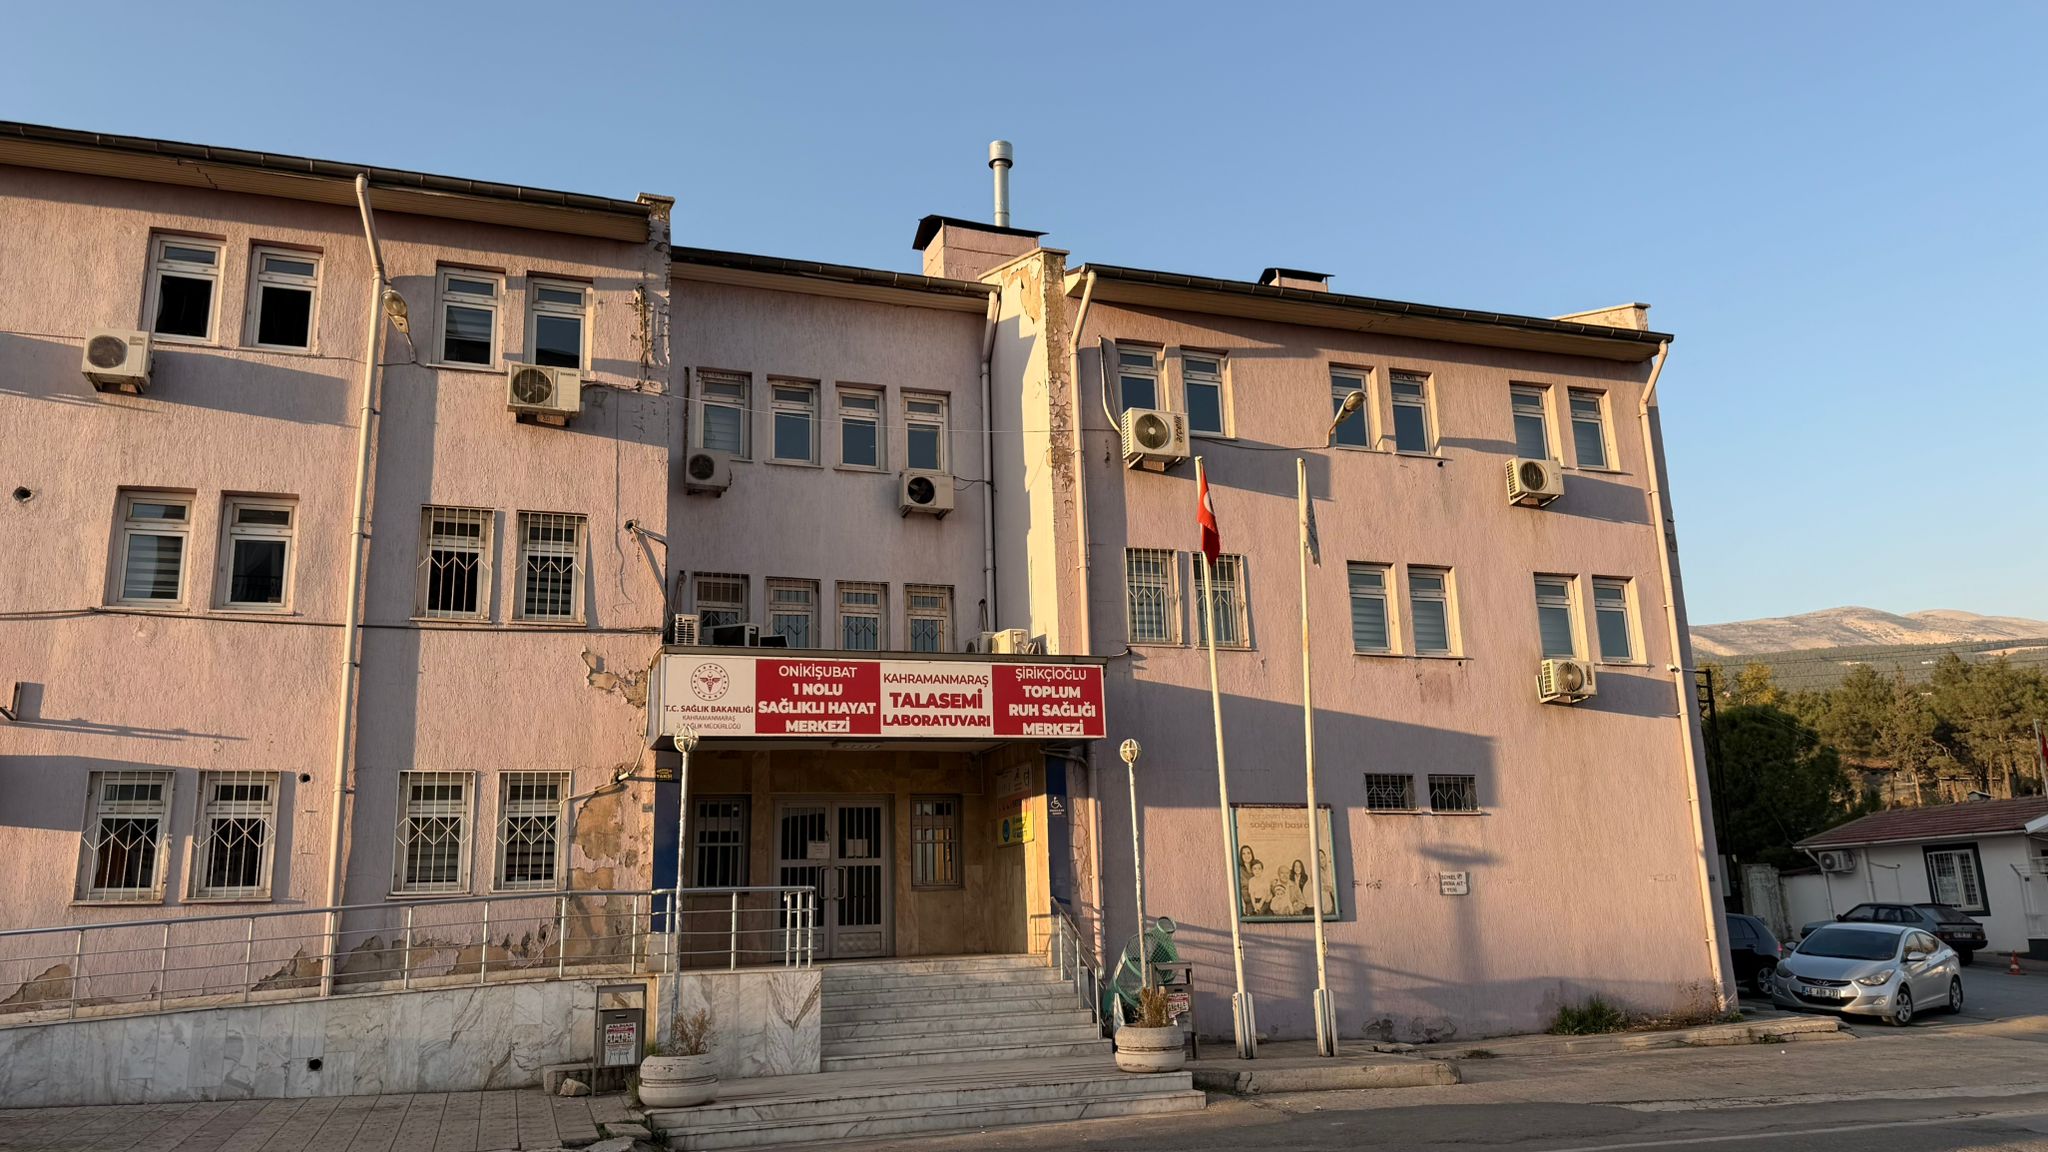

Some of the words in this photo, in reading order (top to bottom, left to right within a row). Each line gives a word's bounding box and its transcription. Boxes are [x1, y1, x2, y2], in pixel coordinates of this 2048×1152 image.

[779, 663, 858, 680] ONİKİŞUBAT
[1015, 666, 1087, 682] ŞİRİKÇİOĞLU
[883, 673, 989, 687] KAHRAMANMARAŞ
[792, 683, 799, 695] 1
[802, 683, 843, 696] NOLU
[1022, 685, 1081, 698] TOPLUM
[758, 698, 825, 714] SAĞLIKLI
[828, 702, 877, 714] HAYAT
[889, 688, 983, 709] TALASEMİ
[680, 704, 709, 713] SAĞLIK
[711, 704, 753, 714] BAKANLIĞI
[1009, 704, 1039, 717] RUH
[1042, 701, 1096, 717] SAĞLIĞI
[786, 716, 850, 732] MERKEZİ
[883, 714, 991, 727] LABORATUVARI
[1022, 719, 1084, 735] MERKEZİ
